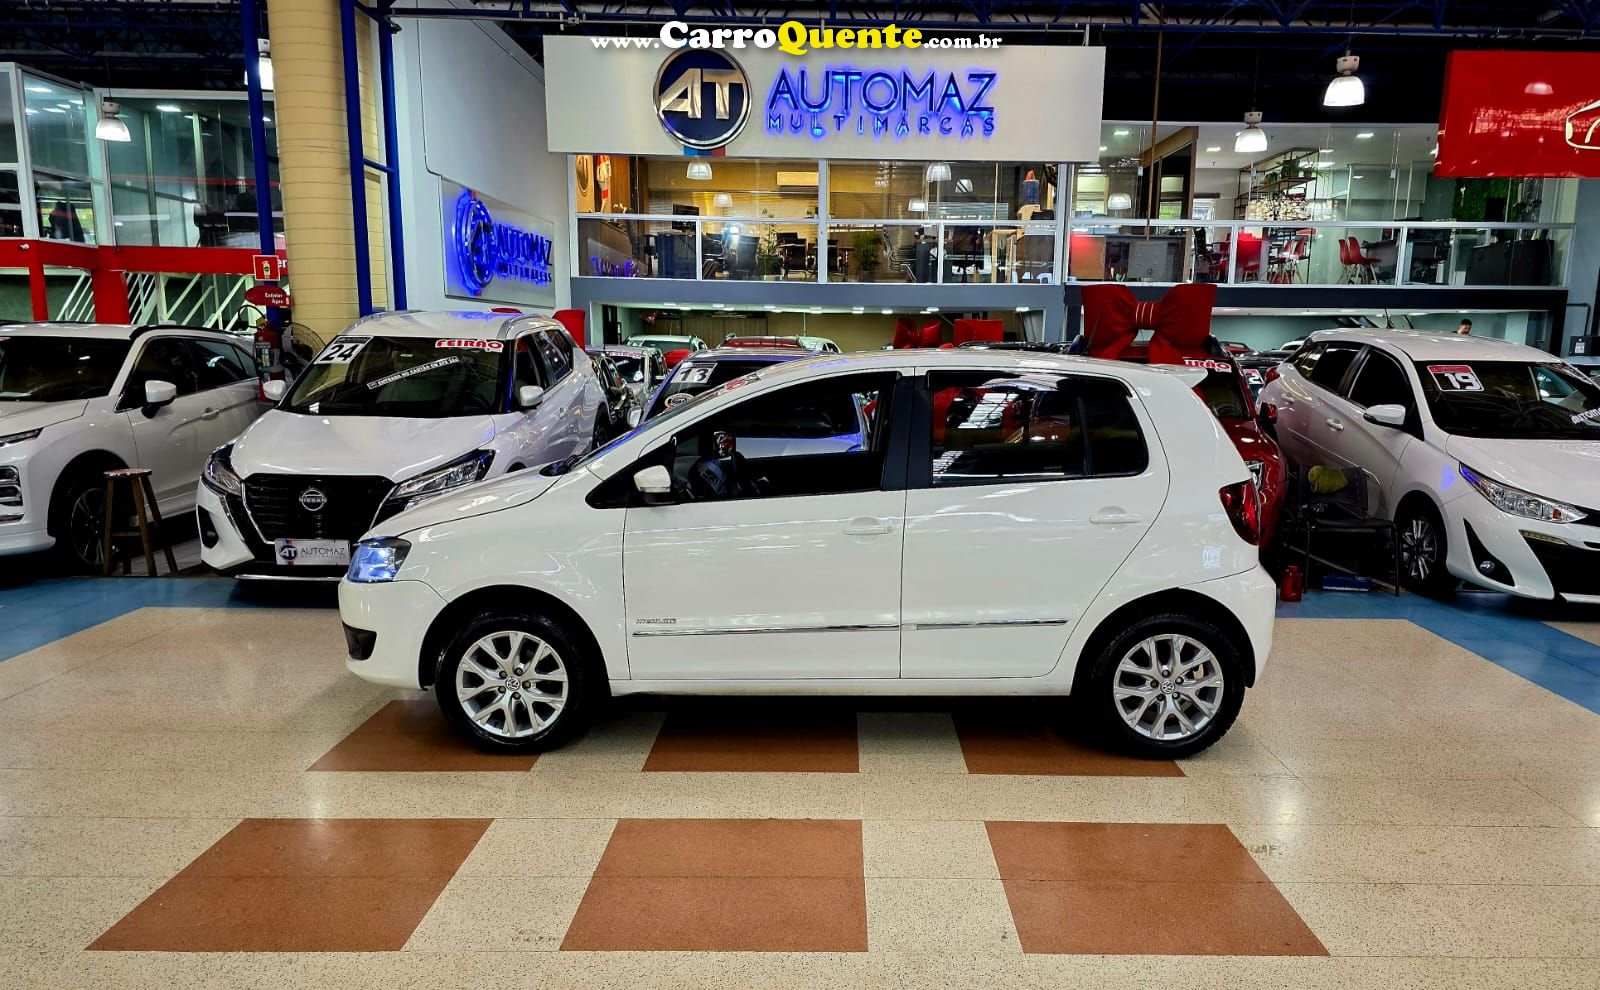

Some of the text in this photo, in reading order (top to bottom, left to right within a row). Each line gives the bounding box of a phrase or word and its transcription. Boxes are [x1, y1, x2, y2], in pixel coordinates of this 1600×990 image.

[660, 67, 746, 120] AT
[769, 68, 998, 113] AUTOMAZ
[768, 113, 995, 136] MULTIMARCAS
[494, 222, 553, 267] AUTOMAZ
[320, 344, 360, 362] 24
[435, 339, 504, 350] FEIRÃO
[680, 368, 709, 382] 13
[1444, 372, 1481, 390] 19
[300, 547, 345, 556] AUTOMAZ
